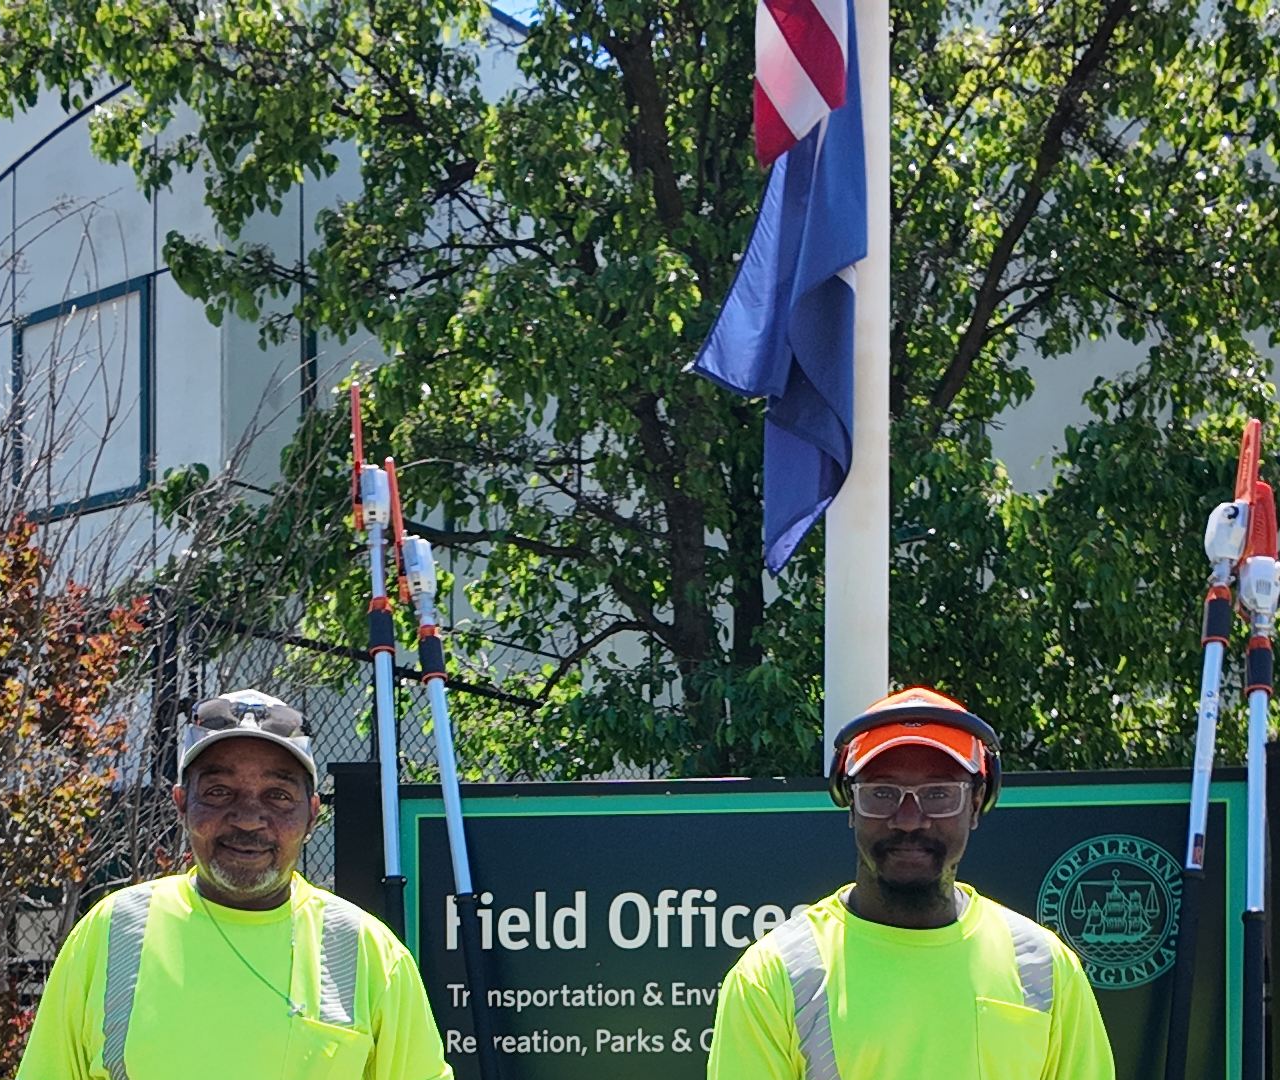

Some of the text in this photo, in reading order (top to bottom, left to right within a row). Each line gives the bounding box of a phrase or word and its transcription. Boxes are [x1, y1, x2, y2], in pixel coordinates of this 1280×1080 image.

[1056, 854, 1085, 881] OF
[1087, 839, 1184, 935] ALEXAND
[447, 983, 636, 1011] Trnsportation
[643, 983, 665, 1006] &
[447, 1028, 588, 1056] Rereation,
[596, 1028, 664, 1053] Parks
[672, 1029, 693, 1053] &
